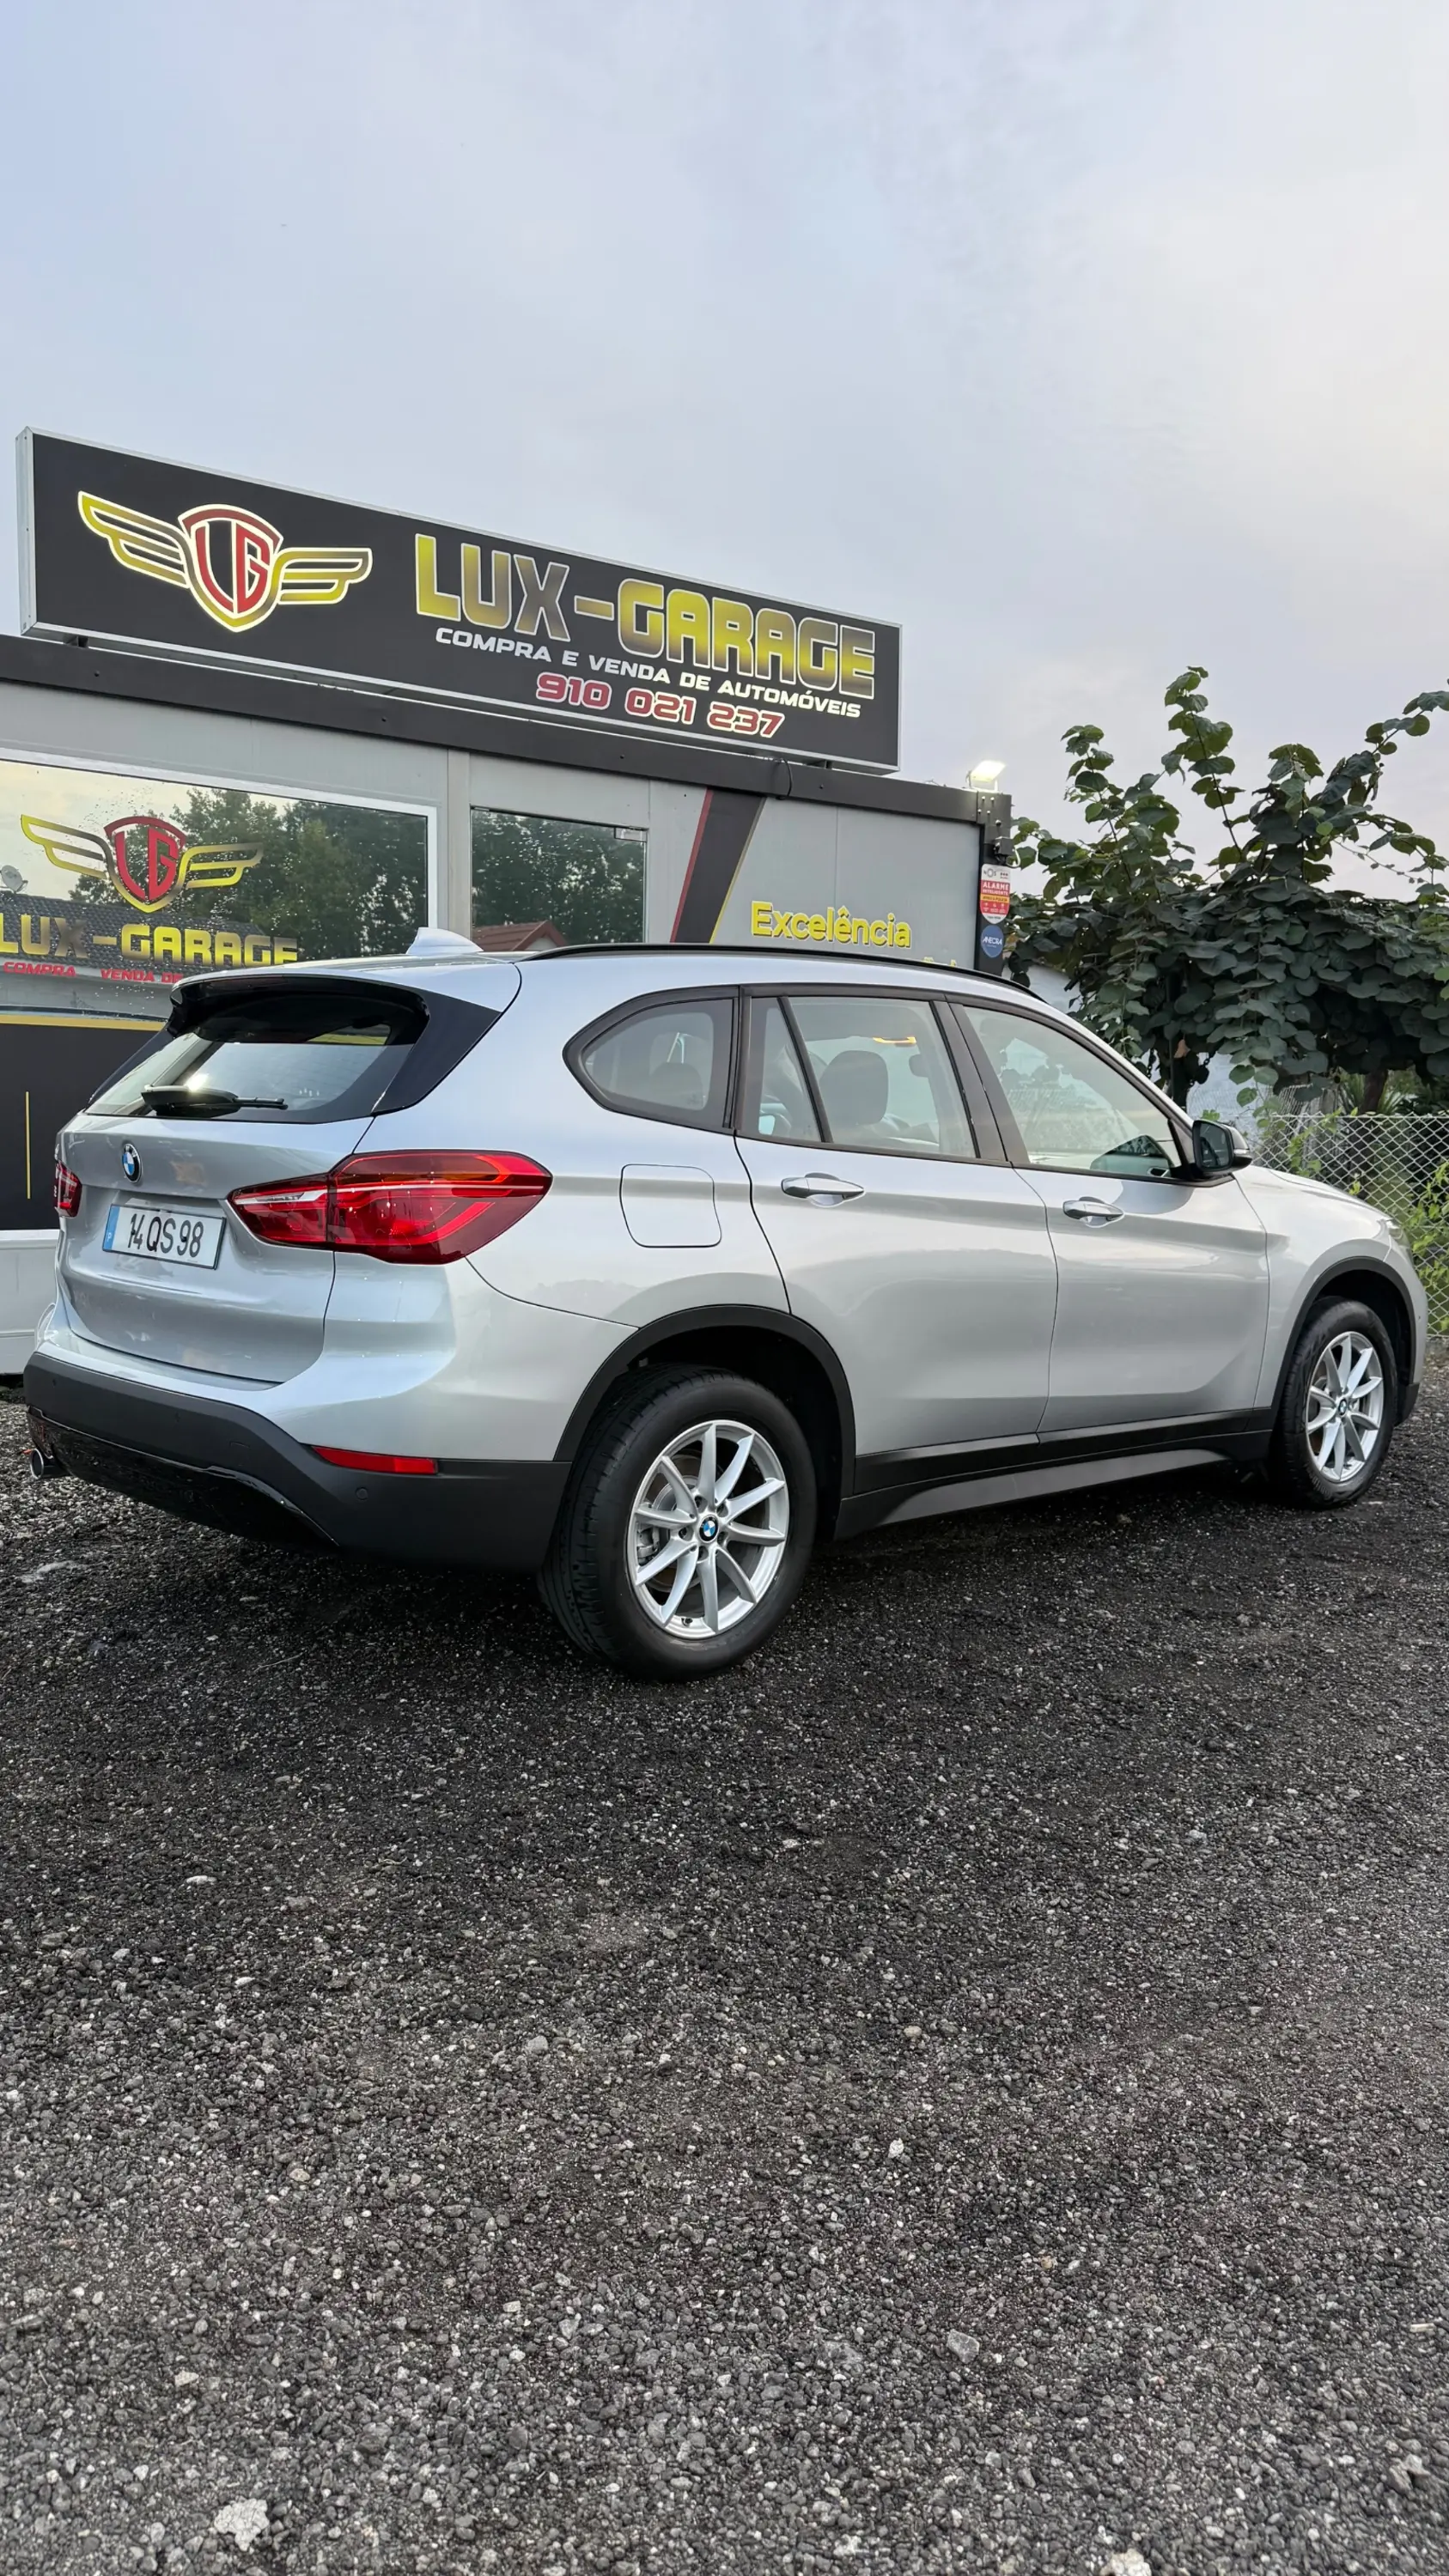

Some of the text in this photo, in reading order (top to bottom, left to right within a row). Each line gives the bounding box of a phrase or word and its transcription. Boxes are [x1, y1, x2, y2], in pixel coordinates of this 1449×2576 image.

[415, 533, 875, 699] LUX-GARAGE
[435, 627, 861, 718] COMPRA E VENDA DE AUTOMÓVEIS
[536, 671, 785, 738] 910 021 237
[983, 881, 1009, 891] ALARME
[752, 901, 911, 950] Excelência
[3, 962, 76, 977] COMPRA
[100, 969, 155, 982] VENDA
